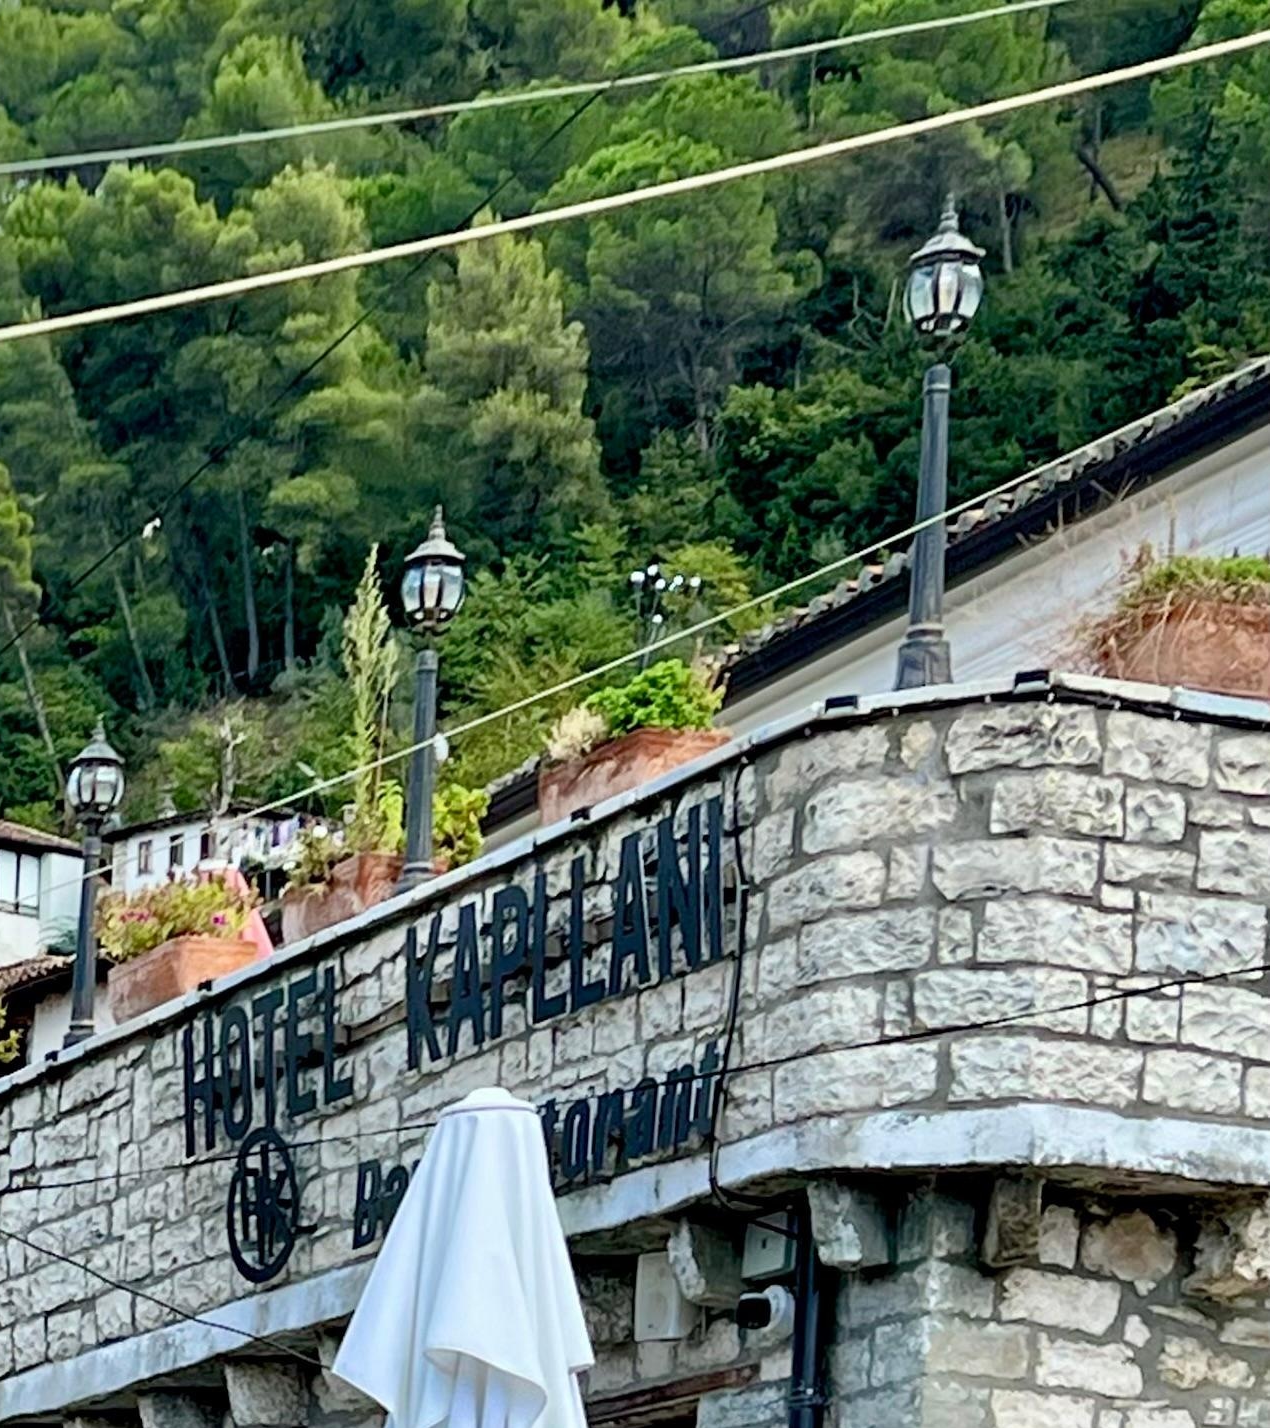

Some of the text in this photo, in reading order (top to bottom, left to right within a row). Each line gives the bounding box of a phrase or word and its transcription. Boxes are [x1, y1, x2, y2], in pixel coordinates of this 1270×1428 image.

[183, 796, 722, 1158] HOTEL KAPLLANI
[353, 1158, 422, 1250] Ba
